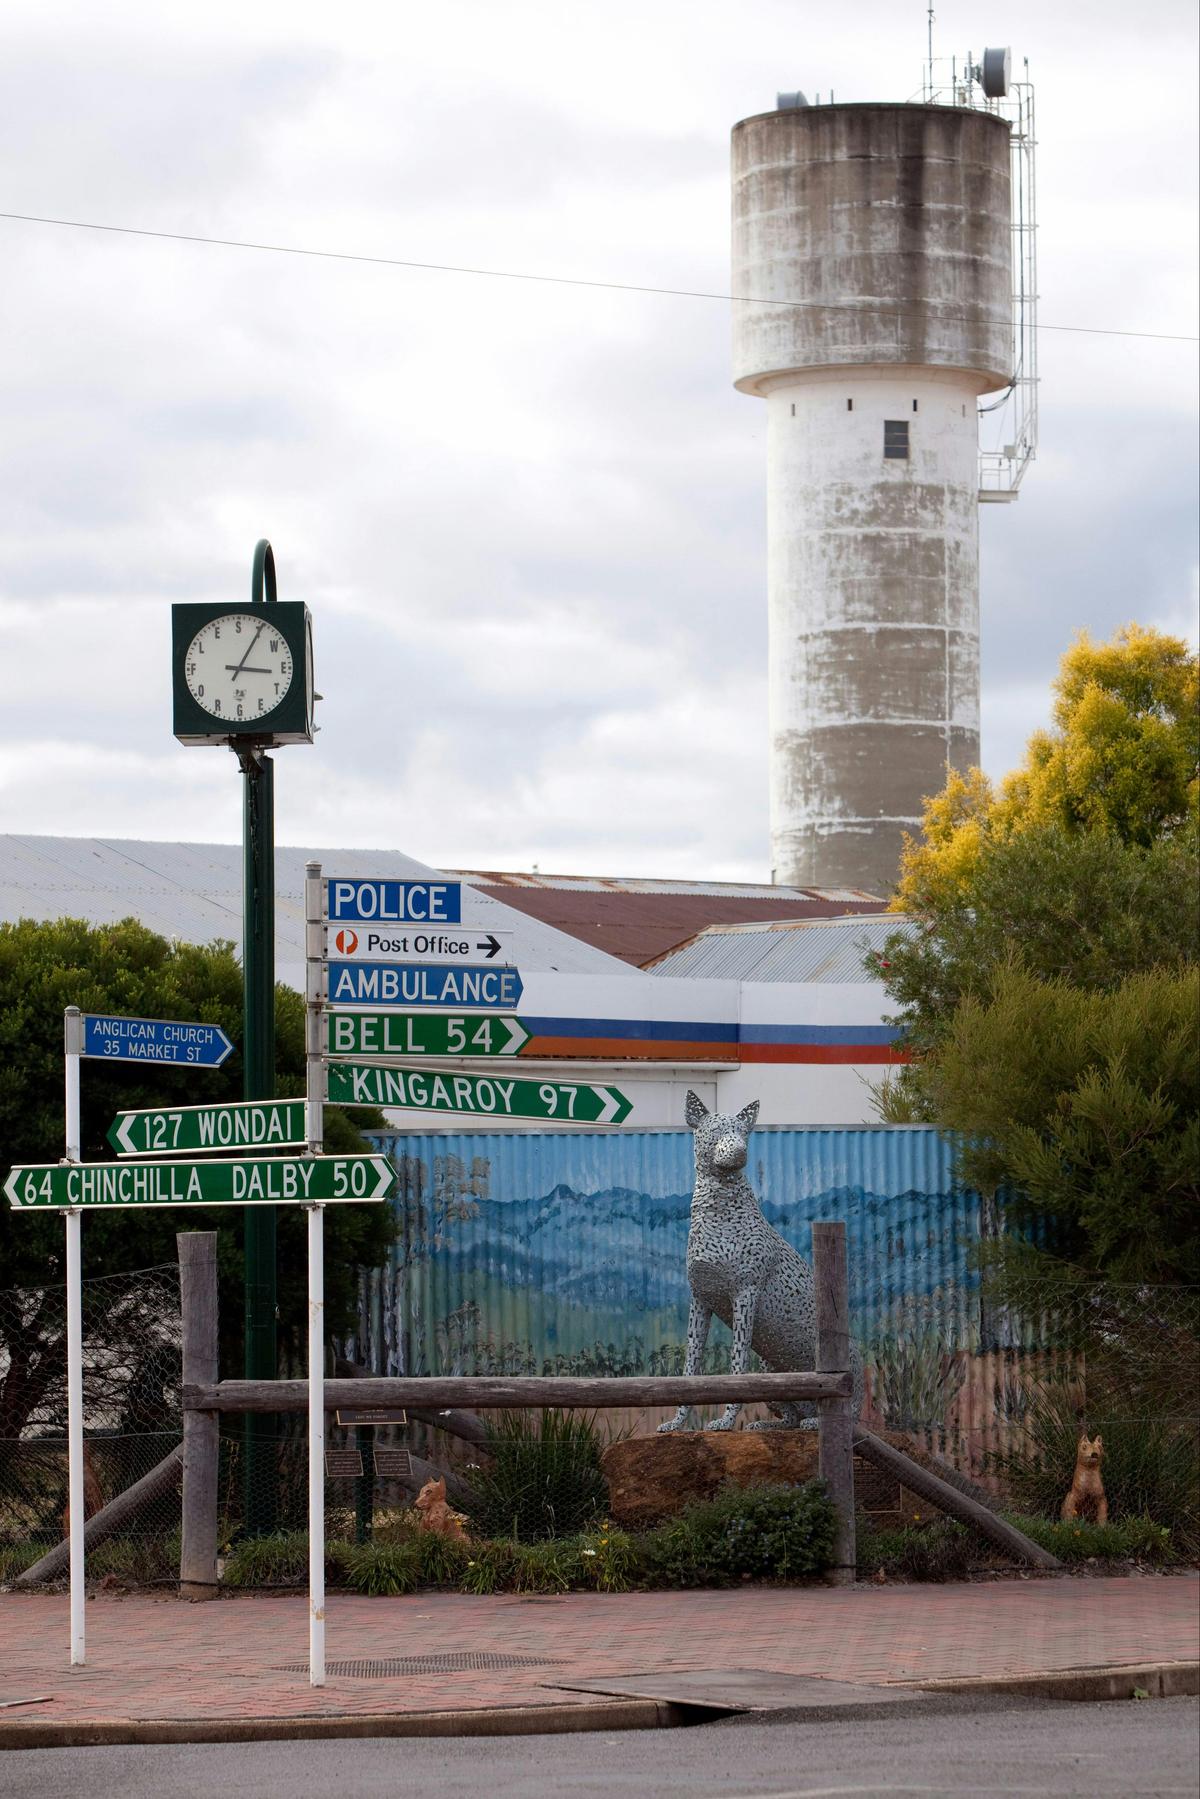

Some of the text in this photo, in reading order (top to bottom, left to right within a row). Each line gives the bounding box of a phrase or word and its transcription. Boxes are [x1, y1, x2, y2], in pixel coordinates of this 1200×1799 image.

[335, 883, 448, 920] POLICE
[368, 934, 470, 955] Post Office
[335, 969, 516, 1003] AMBULANCE
[93, 1020, 214, 1045] ANGLICAN CHURCH
[335, 1016, 493, 1053] BELL 54
[103, 1041, 202, 1062] 35 MARKET ST
[352, 1067, 578, 1118] KINGAROY 97
[144, 1106, 293, 1149] 127 WONDAI
[23, 1160, 368, 1205] 64 CHINCHILLA DALBY 50
